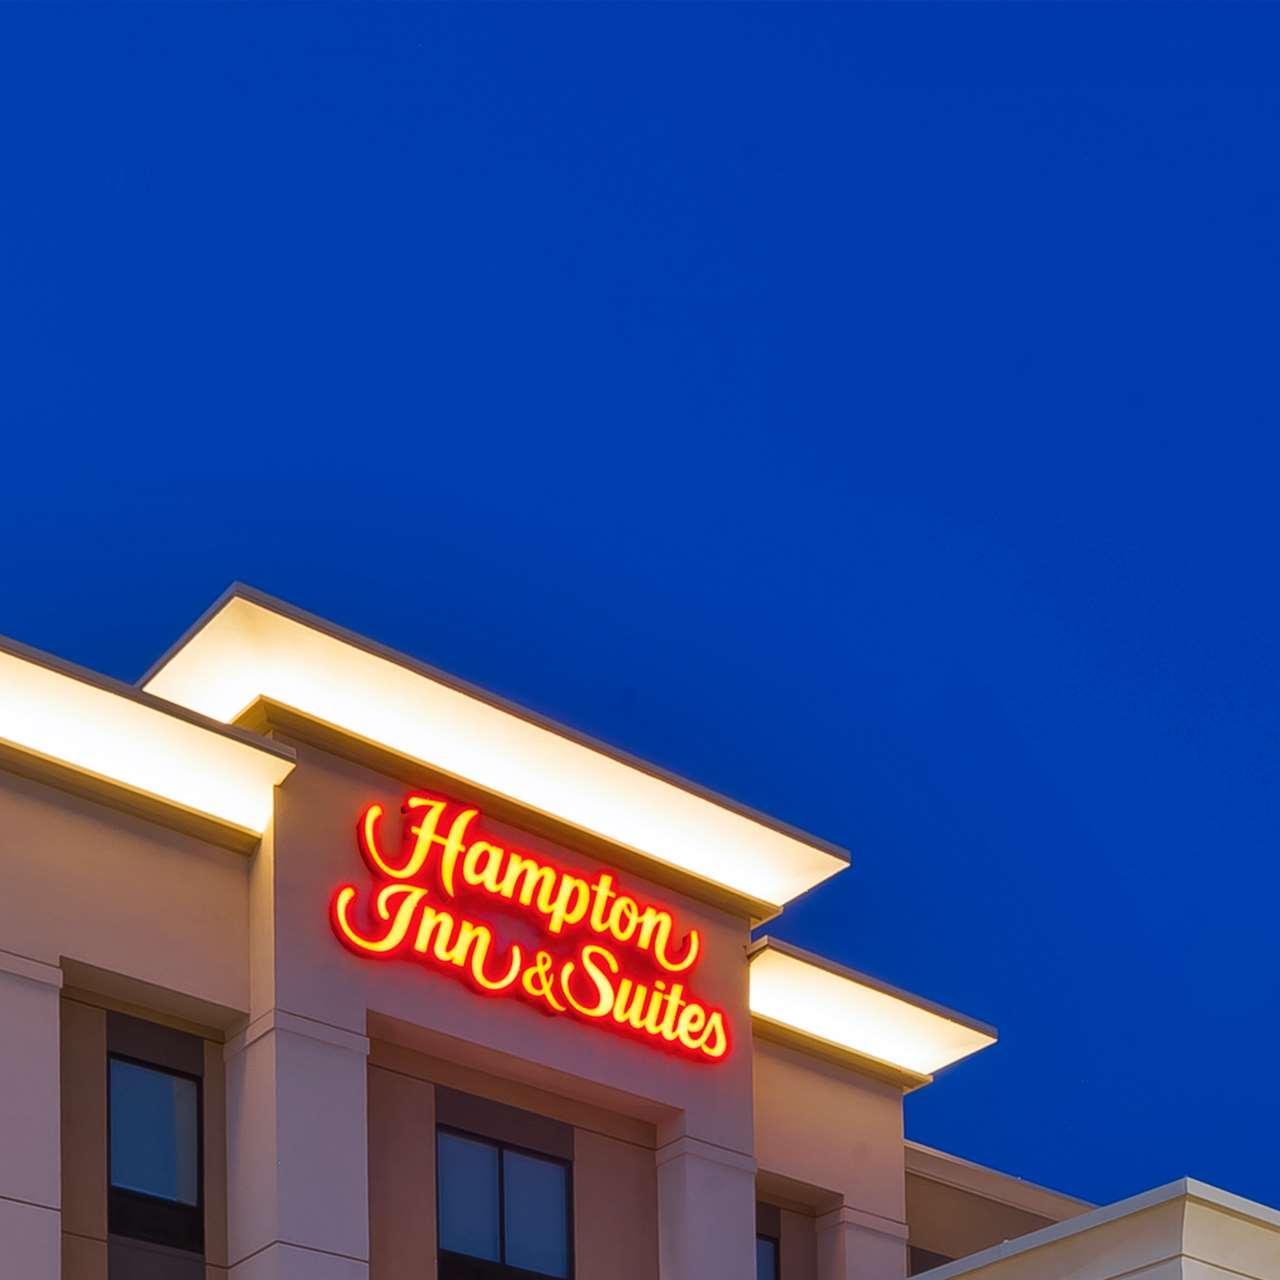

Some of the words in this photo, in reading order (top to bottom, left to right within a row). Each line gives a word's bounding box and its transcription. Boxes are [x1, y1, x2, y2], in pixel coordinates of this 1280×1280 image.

[335, 883, 521, 991] Inn
[521, 950, 567, 1013] &
[560, 943, 729, 1058] Suites
[363, 795, 700, 973] Hampton
